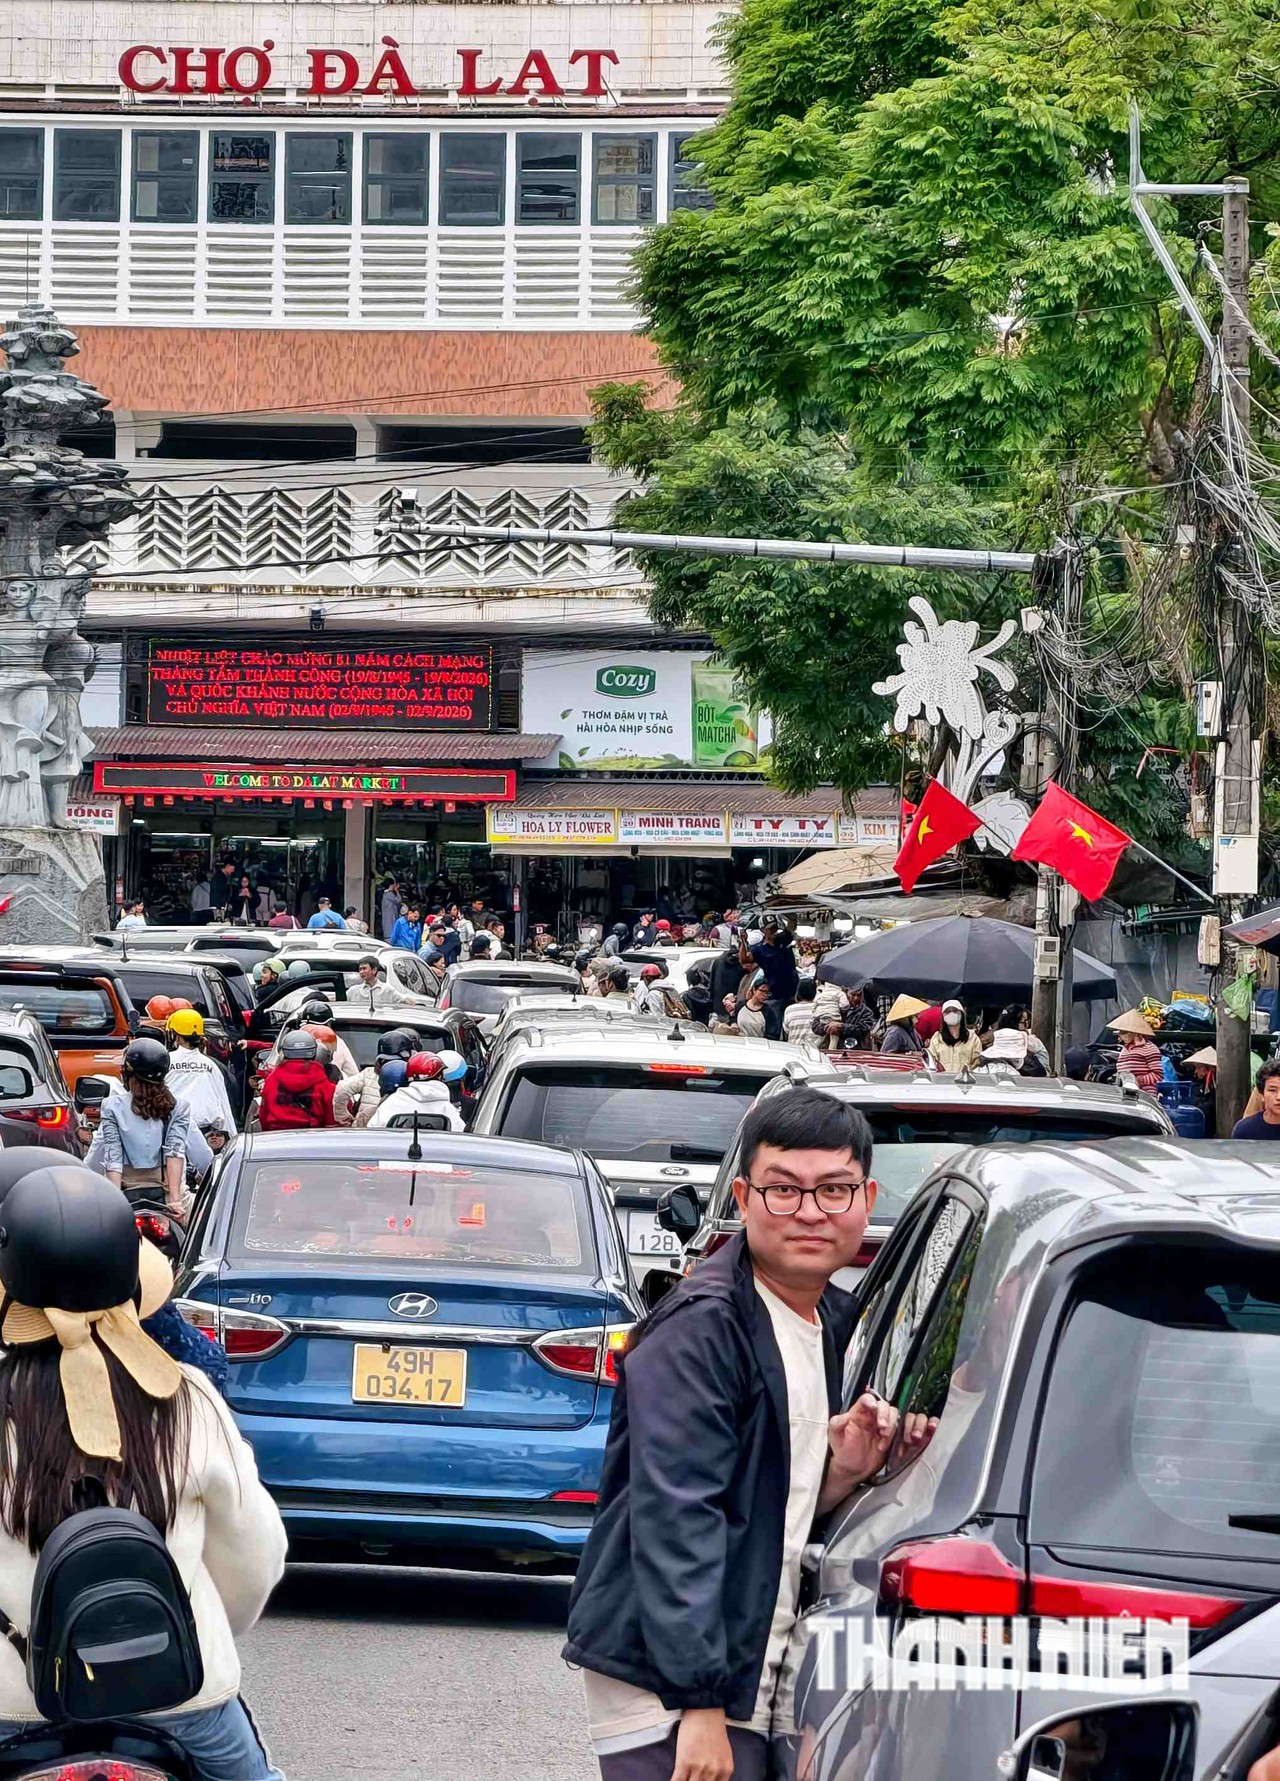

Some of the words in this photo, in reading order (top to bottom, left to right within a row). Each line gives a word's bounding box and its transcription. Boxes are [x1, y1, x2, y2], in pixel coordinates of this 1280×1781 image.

[118, 39, 275, 107] CHỢ
[306, 35, 419, 96] ĐÀ
[456, 48, 620, 106] LẠT
[241, 650, 283, 666] CHÀO
[287, 652, 333, 666] MỪNG
[354, 652, 390, 667] NĂM
[393, 653, 435, 668] CÁCH
[439, 656, 484, 670] MẠNG
[151, 666, 205, 681] THÁNG
[245, 669, 297, 683] THÀNH
[298, 668, 341, 684] CÔNG
[601, 670, 650, 692] Cozy
[165, 683, 187, 697] VÀ
[190, 683, 233, 699] QUỐC
[235, 684, 290, 699] KHÁNH
[293, 684, 337, 700] NƯỚC
[339, 686, 383, 702] CỘNG
[385, 685, 418, 701] HÒA
[422, 687, 444, 701] XÃ
[165, 697, 199, 714] CHỦ
[201, 700, 250, 715] NGHĨA
[252, 702, 287, 717] VIỆT
[289, 703, 325, 717] NAM
[697, 704, 715, 724] BỘT
[582, 710, 611, 719] THƠM
[614, 710, 635, 722] ĐẬM
[637, 712, 647, 723] VỊ
[649, 710, 668, 720] TRÀ
[576, 722, 593, 732] HÀI
[596, 723, 617, 733] HÒA
[619, 725, 643, 735] NHỊP
[645, 724, 673, 734] SỐNG
[697, 726, 737, 743] MATCHA
[202, 773, 270, 787] WELCOME
[272, 775, 291, 787] TO
[293, 775, 339, 788] DALAT
[341, 776, 399, 789] MARKET
[522, 821, 545, 833] HOA
[549, 821, 562, 833] LY
[566, 822, 612, 834] FLOWER
[639, 818, 673, 828] MINH
[678, 817, 720, 829] TRANG
[750, 820, 784, 829] TY
[795, 820, 828, 830] TY
[863, 823, 886, 835] KIM
[890, 824, 898, 835] T
[640, 1235, 679, 1251] 128.
[388, 1351, 433, 1374] 49H
[366, 1374, 452, 1401] 034.17
